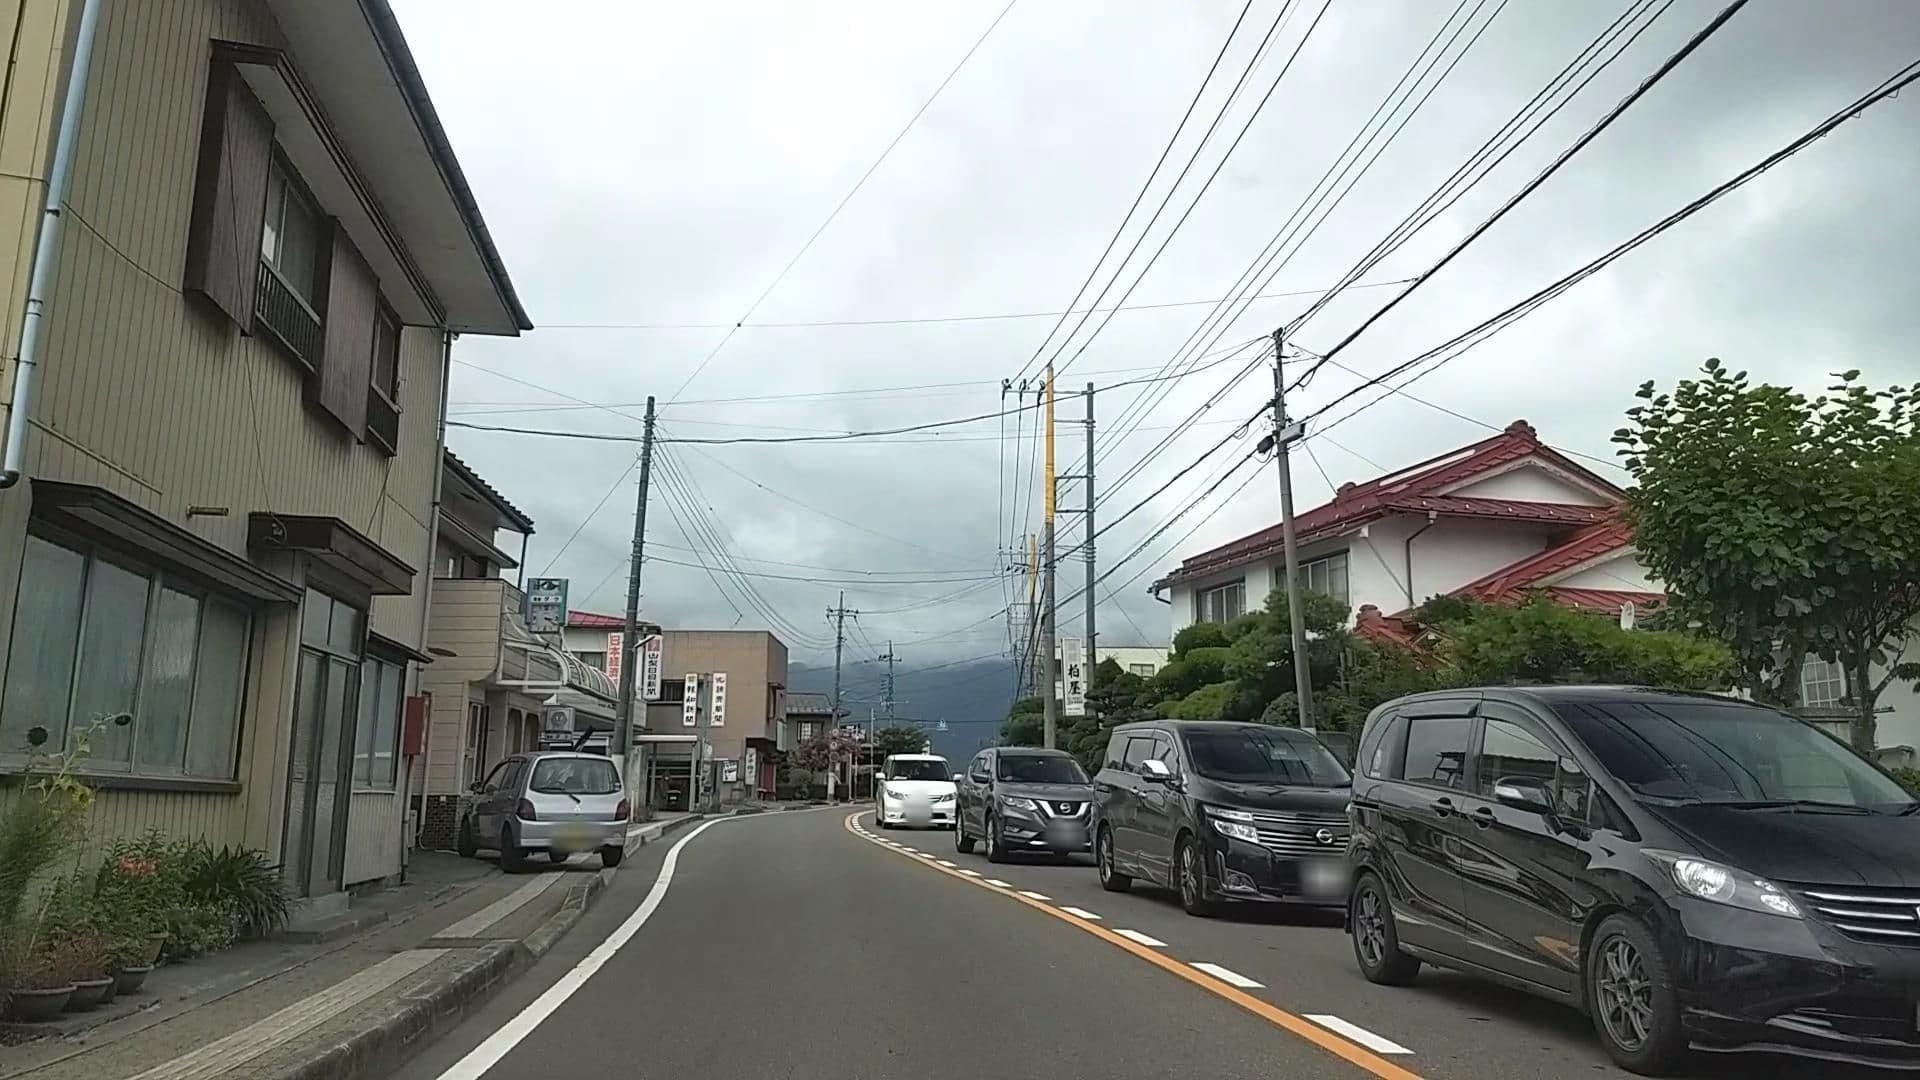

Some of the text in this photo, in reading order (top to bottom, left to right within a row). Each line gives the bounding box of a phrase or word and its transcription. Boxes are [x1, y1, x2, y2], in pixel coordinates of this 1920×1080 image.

[647, 652, 659, 696] 山梨日日新聞
[1068, 664, 1080, 694] 柏屋
